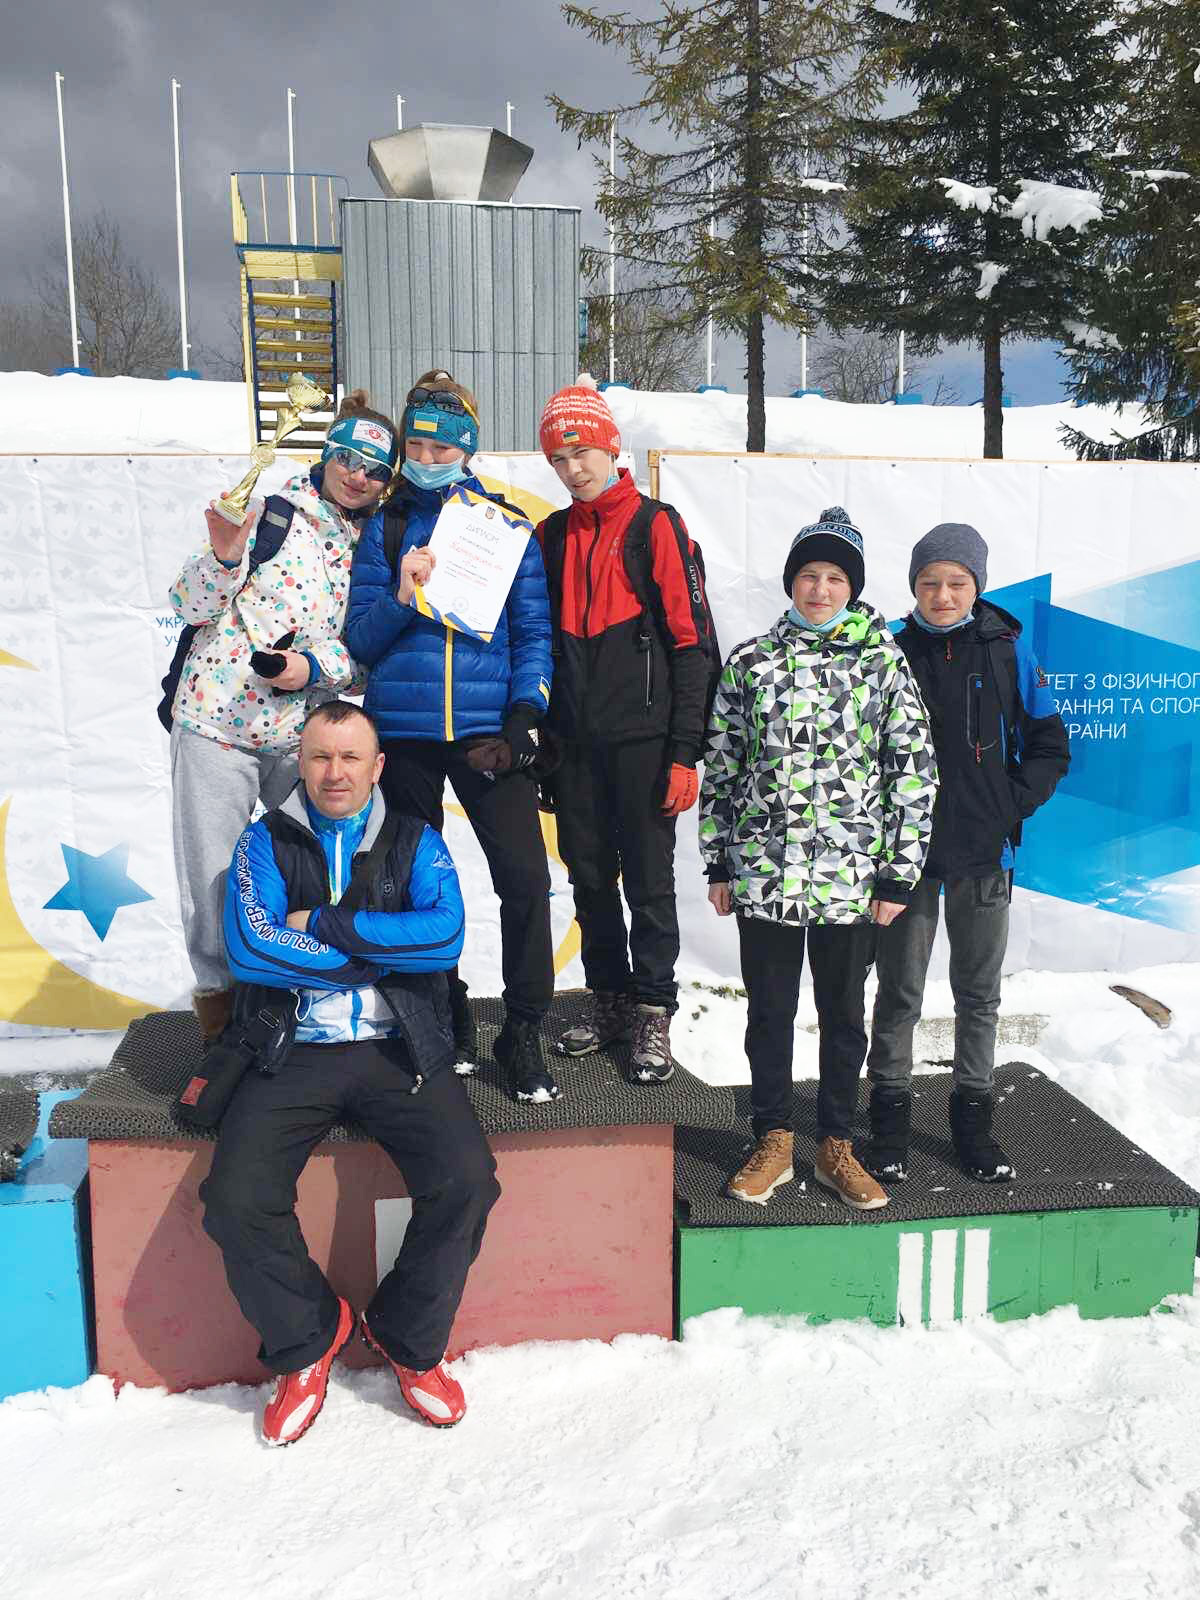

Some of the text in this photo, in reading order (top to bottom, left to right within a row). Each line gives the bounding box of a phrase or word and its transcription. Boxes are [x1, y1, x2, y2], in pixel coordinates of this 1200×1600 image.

[155, 616, 185, 628] УКР
[1119, 698, 1145, 714] ТА
[1064, 719, 1126, 739] РАЇНИ
